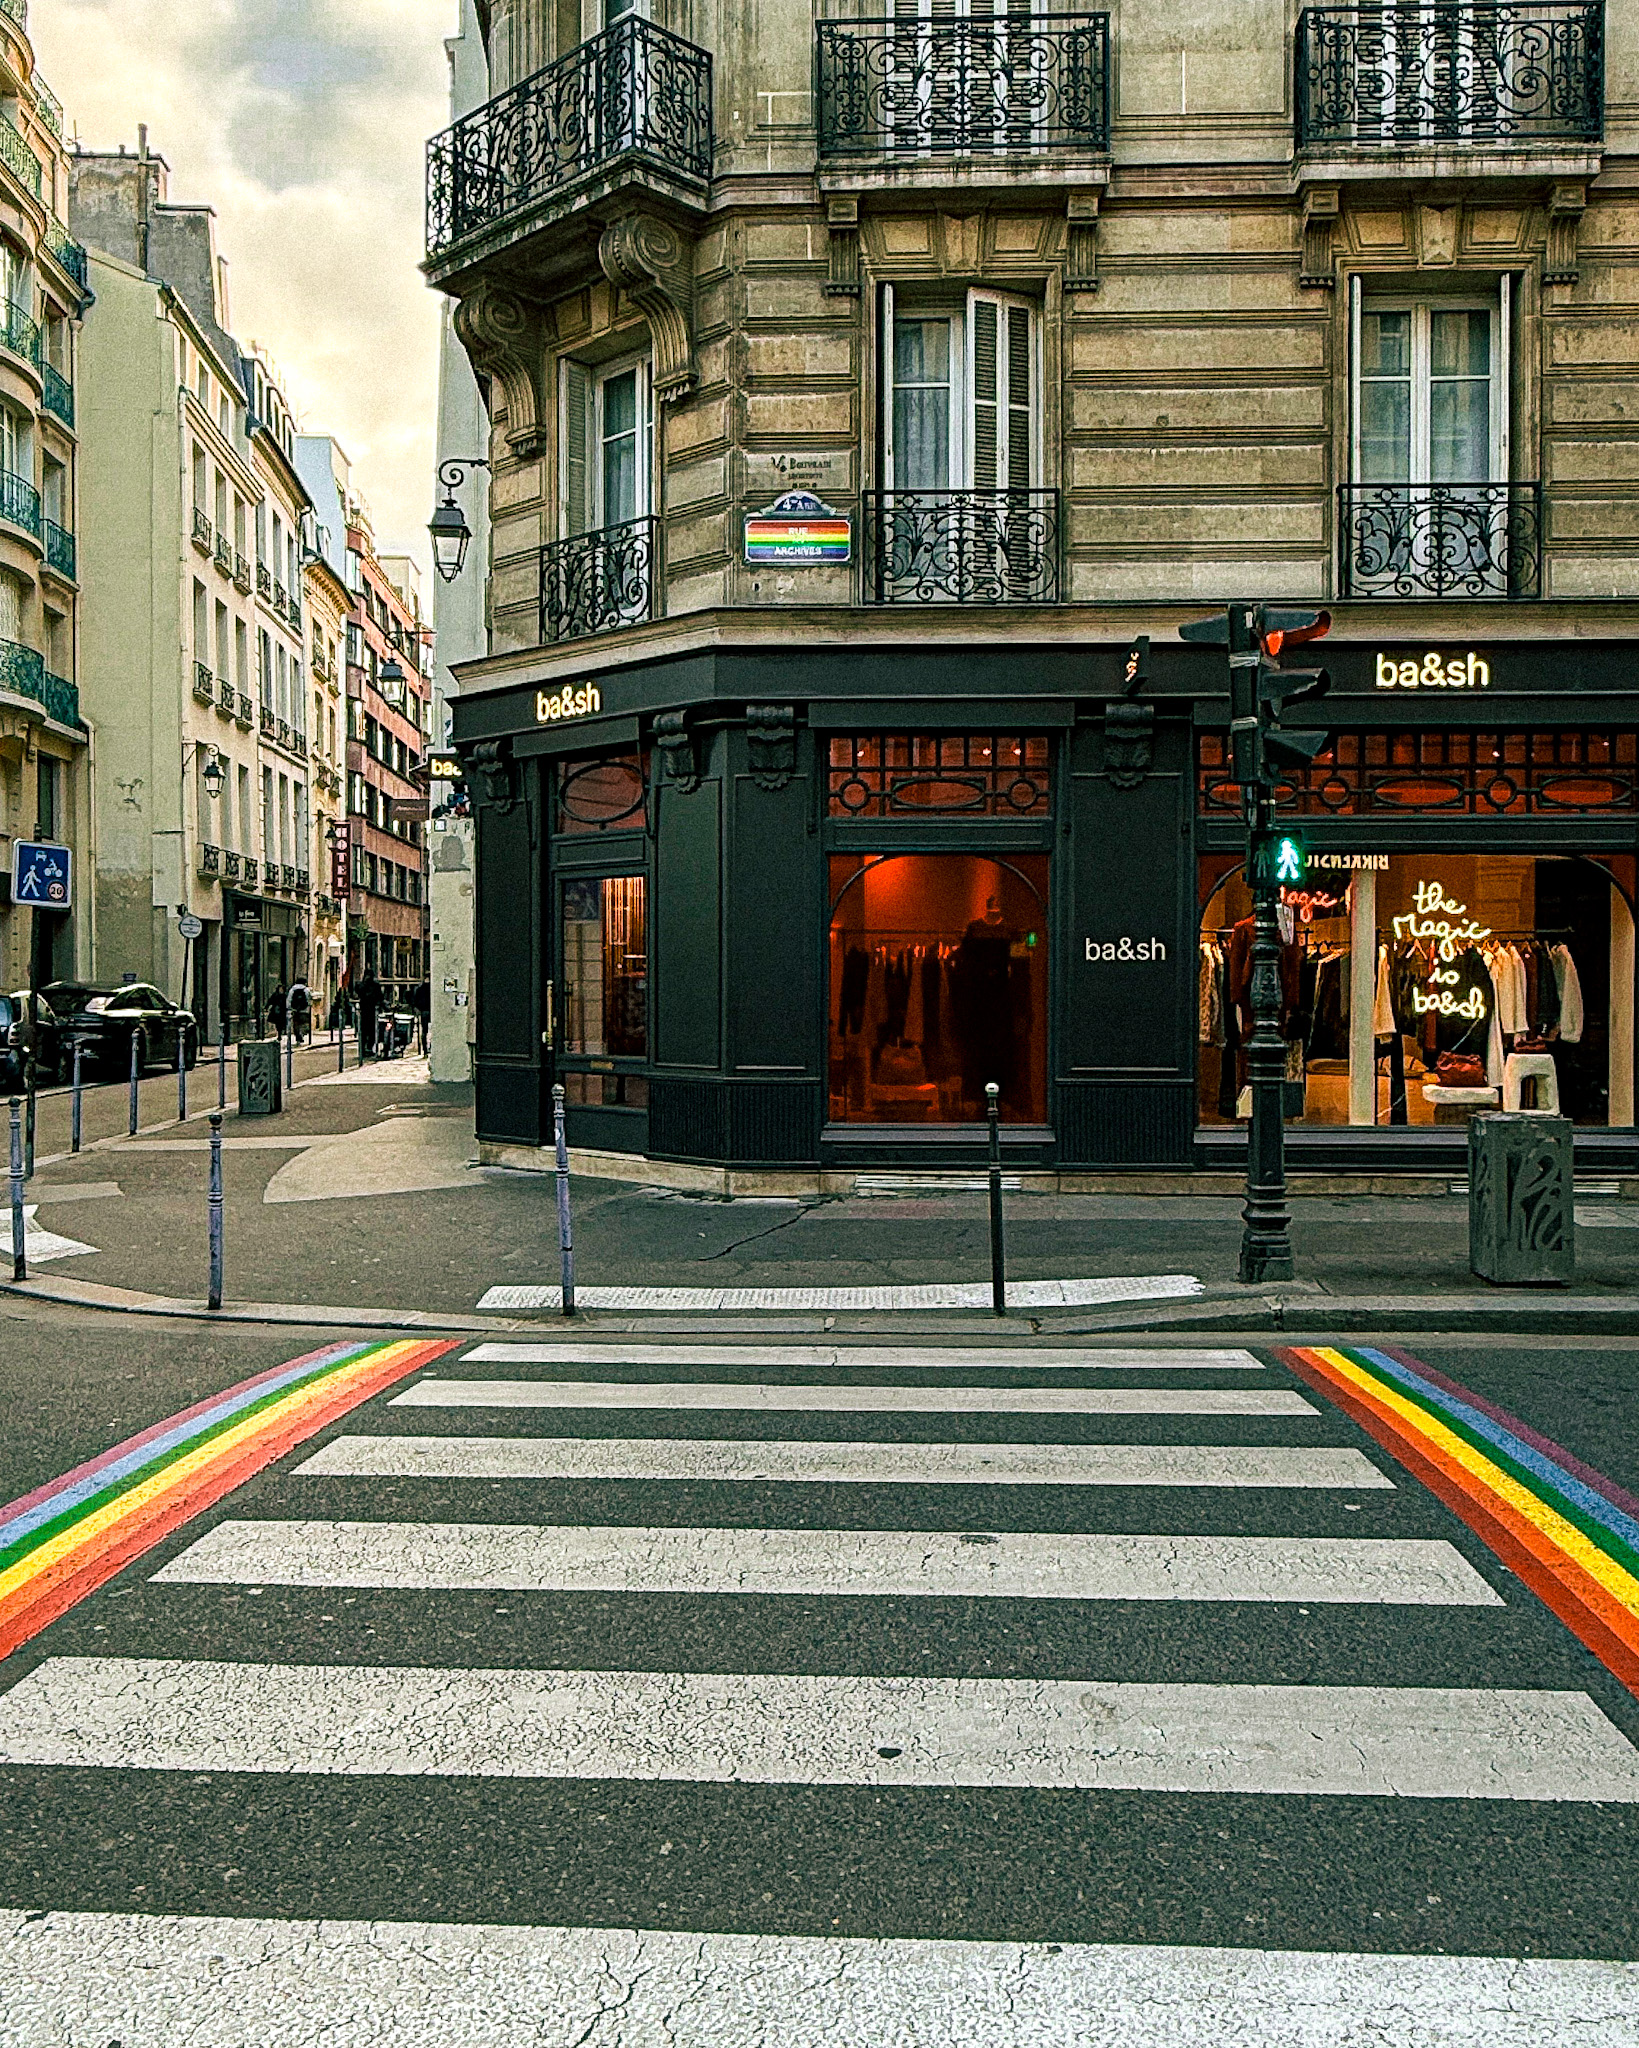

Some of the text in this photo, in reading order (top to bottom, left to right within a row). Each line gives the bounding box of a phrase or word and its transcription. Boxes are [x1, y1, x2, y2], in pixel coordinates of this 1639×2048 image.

[788, 527, 808, 536] RUE
[774, 547, 822, 556] ARCHIVES
[1376, 651, 1488, 687] ba&sh
[536, 681, 600, 721] ba&sh
[335, 827, 348, 888] HOTEL
[50, 886, 63, 895] 20
[1412, 880, 1467, 914] the
[1085, 937, 1166, 961] ba&sh
[1428, 958, 1460, 985] is
[1412, 986, 1485, 1019] ba&sh
